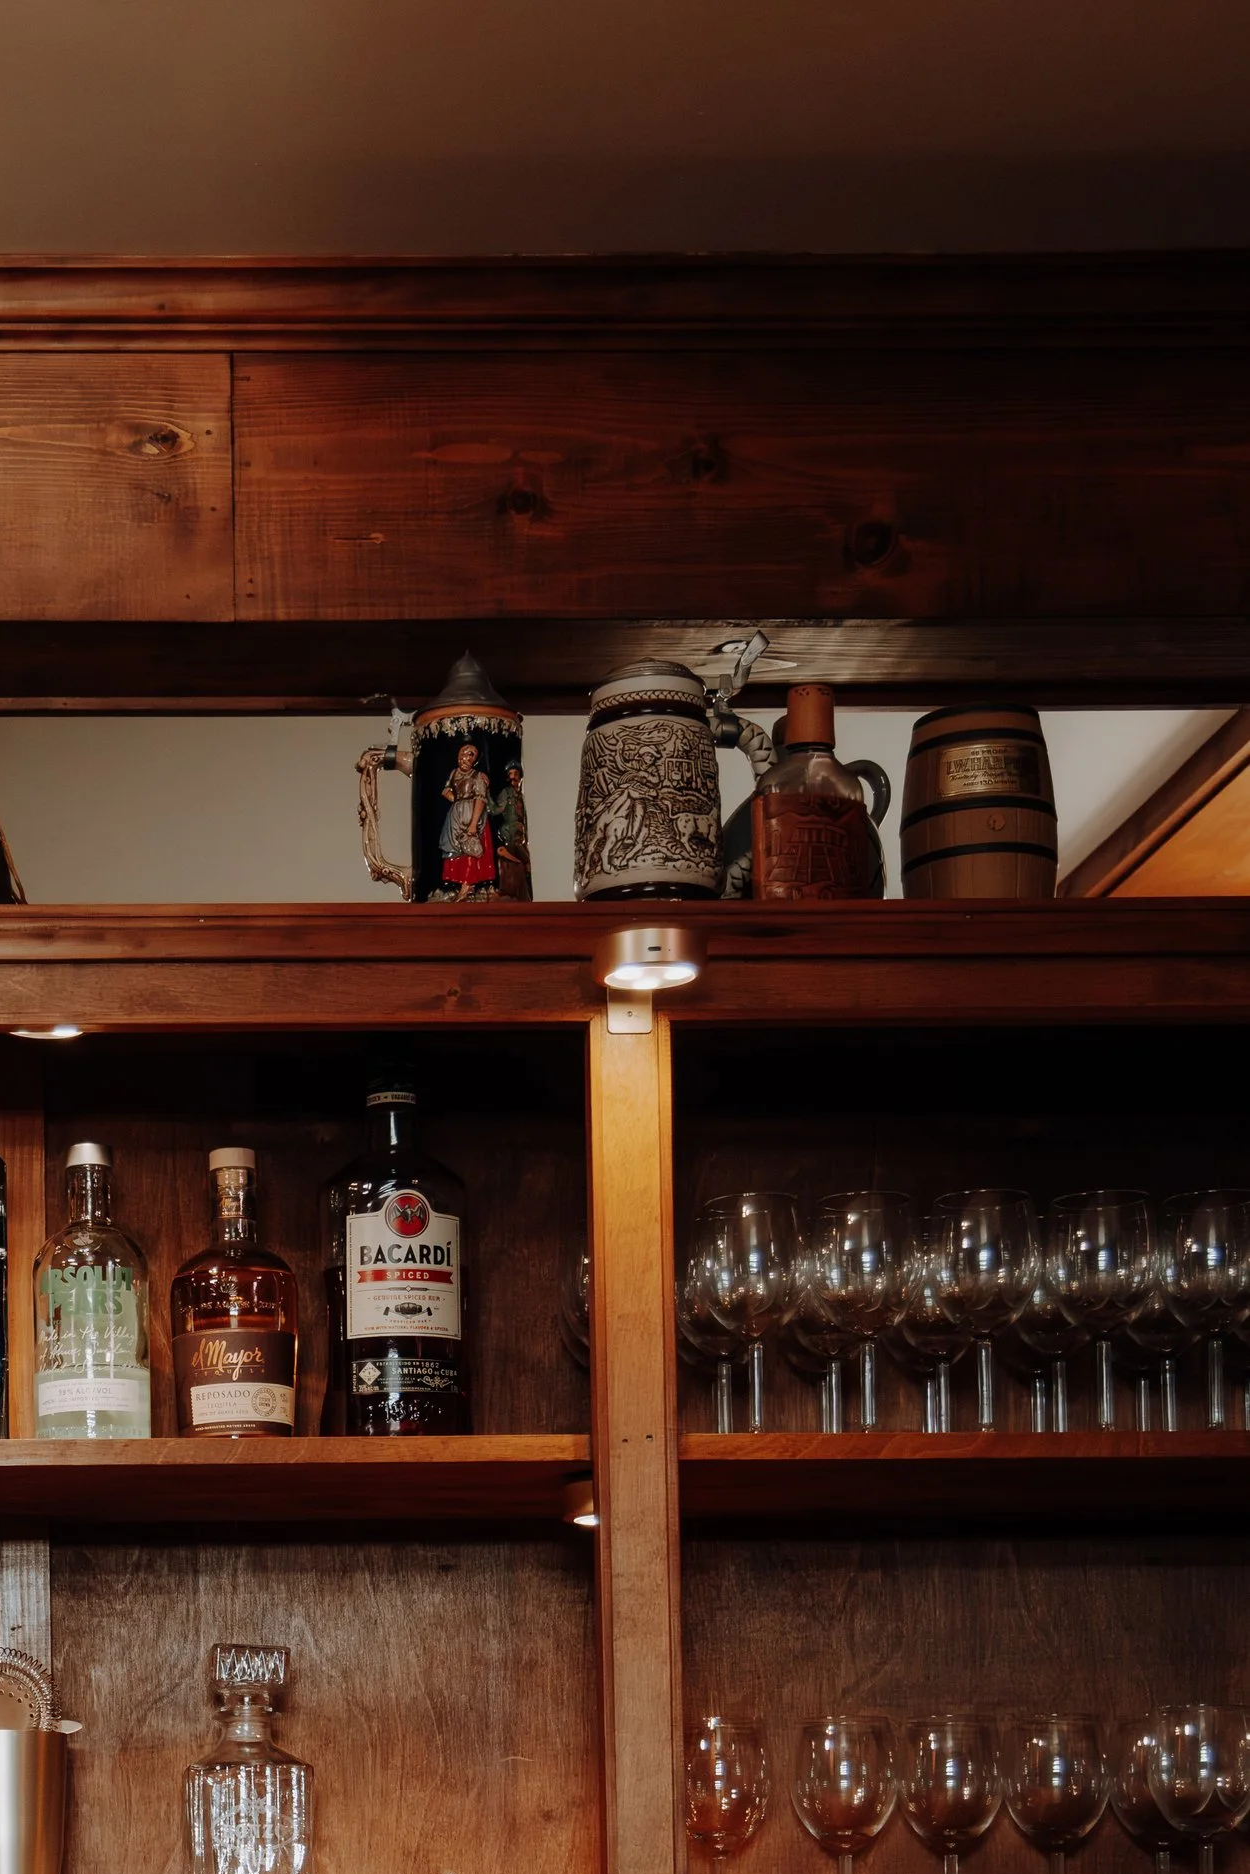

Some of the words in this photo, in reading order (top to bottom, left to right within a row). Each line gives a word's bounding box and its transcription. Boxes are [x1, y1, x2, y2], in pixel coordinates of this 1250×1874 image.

[360, 1241, 452, 1266] BACARDÍ
[40, 1265, 133, 1292] ABSOLUT
[386, 1271, 430, 1279] SPICED
[104, 1325, 136, 1346] Villag
[192, 1338, 206, 1370] el
[205, 1340, 265, 1381] Mayor
[391, 1367, 433, 1375] SANTIAGO
[195, 1389, 251, 1401] REPOSADO
[207, 1401, 237, 1409] TEQUILA
